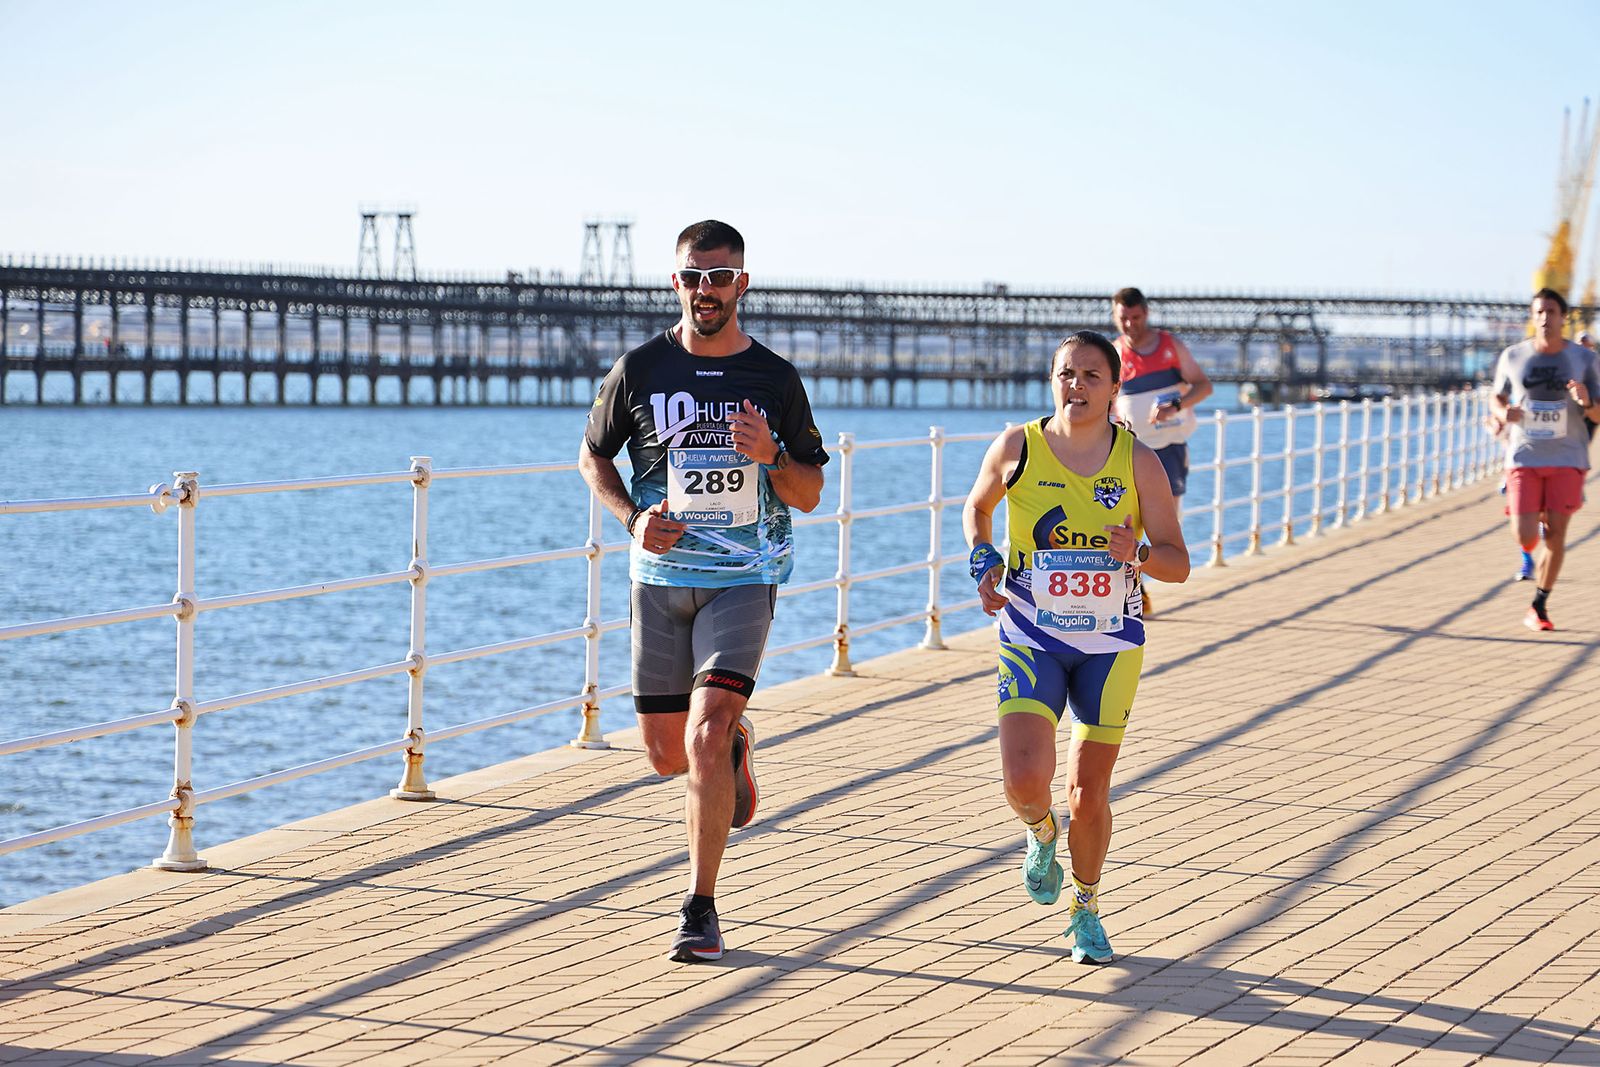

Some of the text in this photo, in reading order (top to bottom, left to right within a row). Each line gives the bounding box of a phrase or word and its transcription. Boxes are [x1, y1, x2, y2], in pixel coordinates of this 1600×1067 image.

[695, 401, 767, 423] HUELA
[1533, 411, 1560, 422] 780
[689, 432, 735, 447] AVATE
[687, 454, 707, 462] HUELVA
[684, 469, 745, 495] 289
[684, 511, 727, 522] Wayalia
[1055, 525, 1108, 548] Sne
[1048, 571, 1112, 597] 838
[1051, 613, 1090, 627] Wayalia
